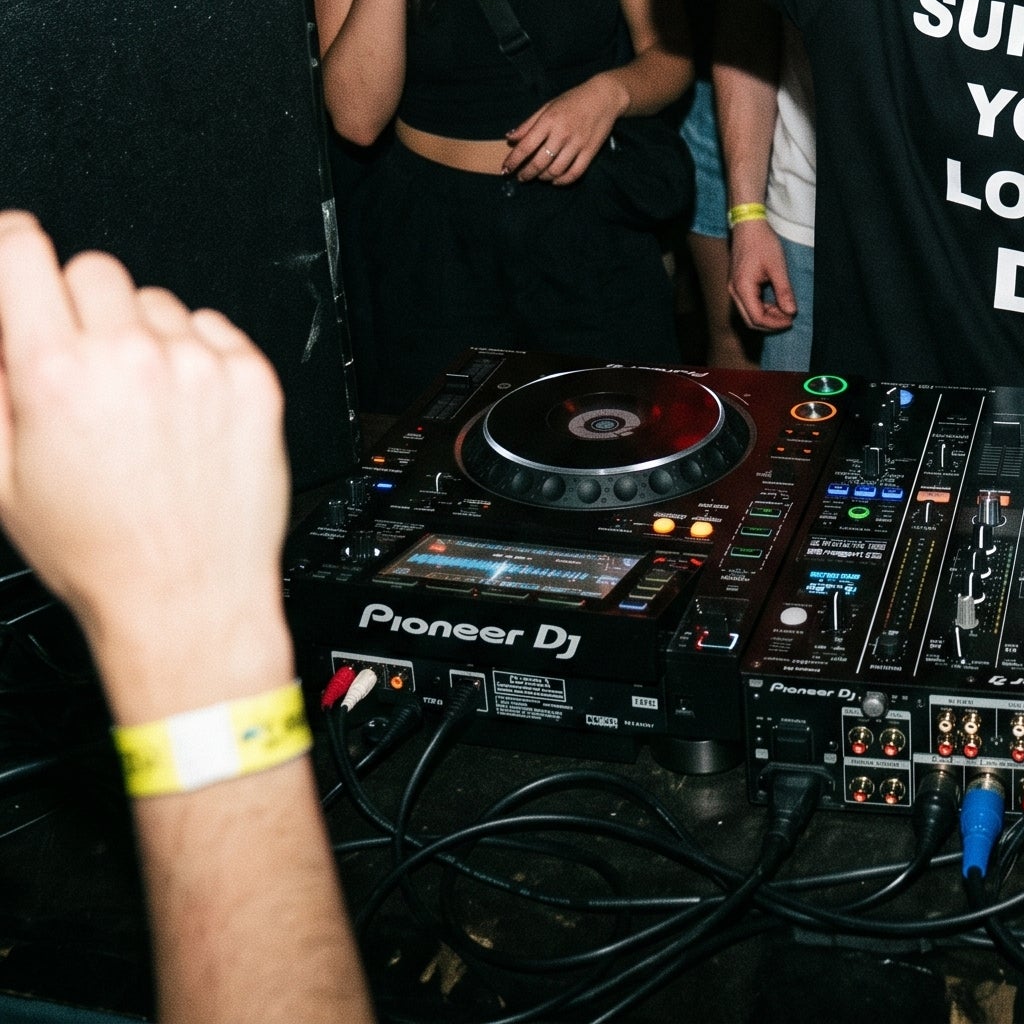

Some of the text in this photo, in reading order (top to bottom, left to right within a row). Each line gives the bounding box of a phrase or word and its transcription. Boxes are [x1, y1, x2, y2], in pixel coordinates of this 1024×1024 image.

[358, 602, 582, 660] Pioneer DJ
[769, 682, 835, 698] Pioneer
